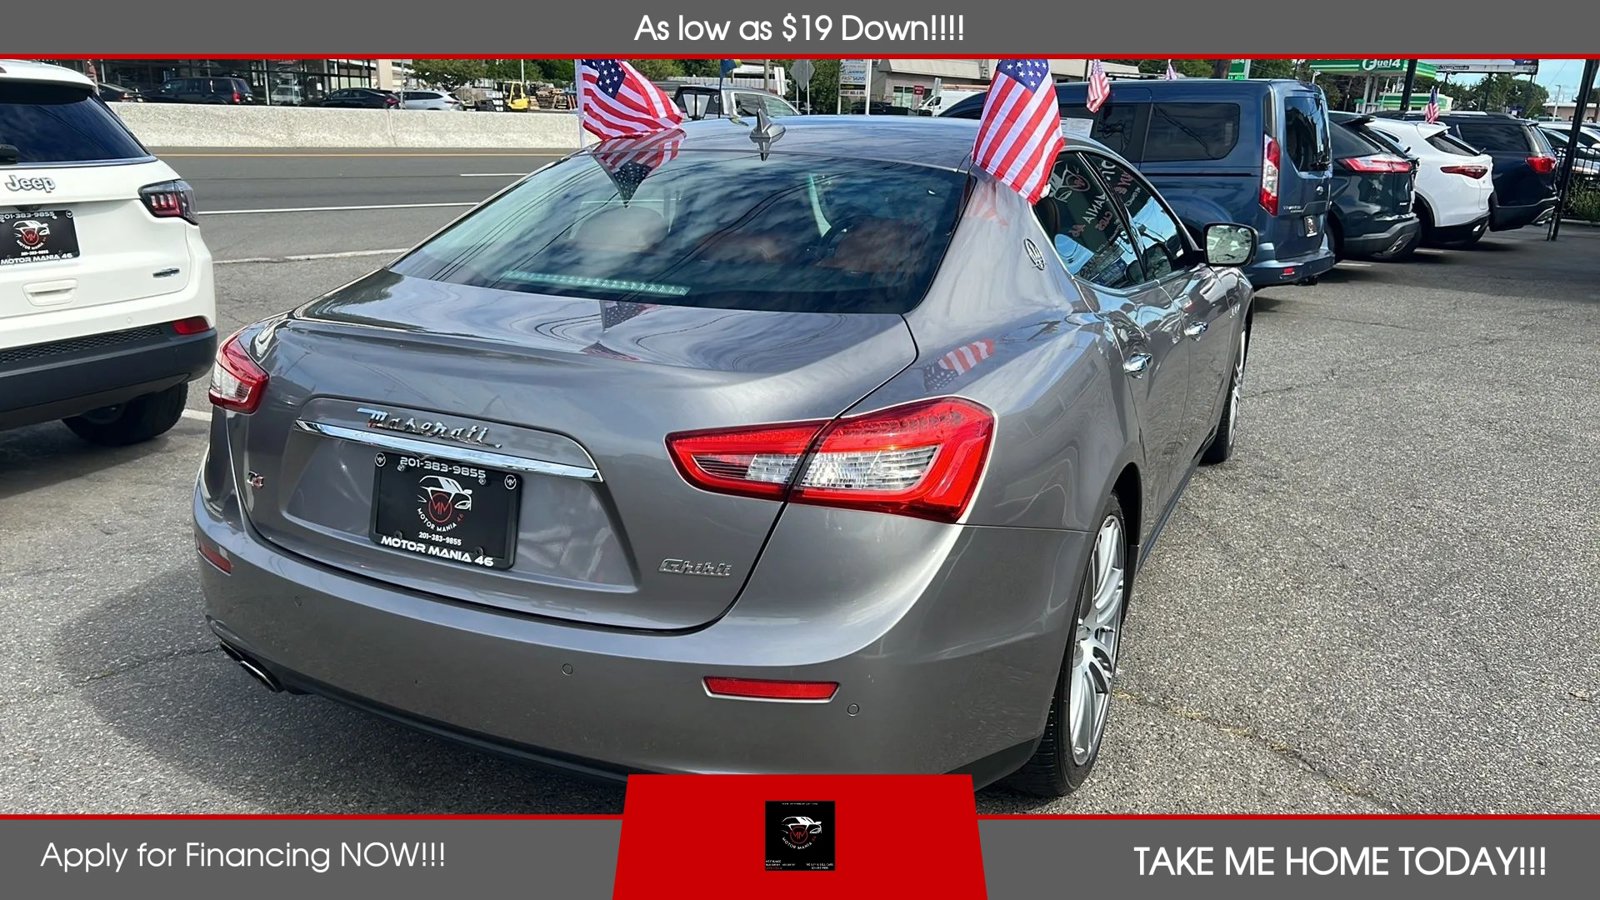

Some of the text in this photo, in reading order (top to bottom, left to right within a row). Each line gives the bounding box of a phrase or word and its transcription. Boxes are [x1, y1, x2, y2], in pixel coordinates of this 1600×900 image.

[4, 174, 57, 194] Jeep
[0, 257, 32, 265] MOTOR
[32, 254, 60, 262] MANIA
[357, 407, 502, 449] Maserati
[400, 456, 487, 479] 201-383-9855
[417, 507, 436, 530] MOTOR
[436, 522, 457, 532] MANIA
[418, 531, 462, 546] 201-383-9855
[381, 536, 494, 567] MOTOR MANIA 46
[659, 558, 732, 577] Ghibli
